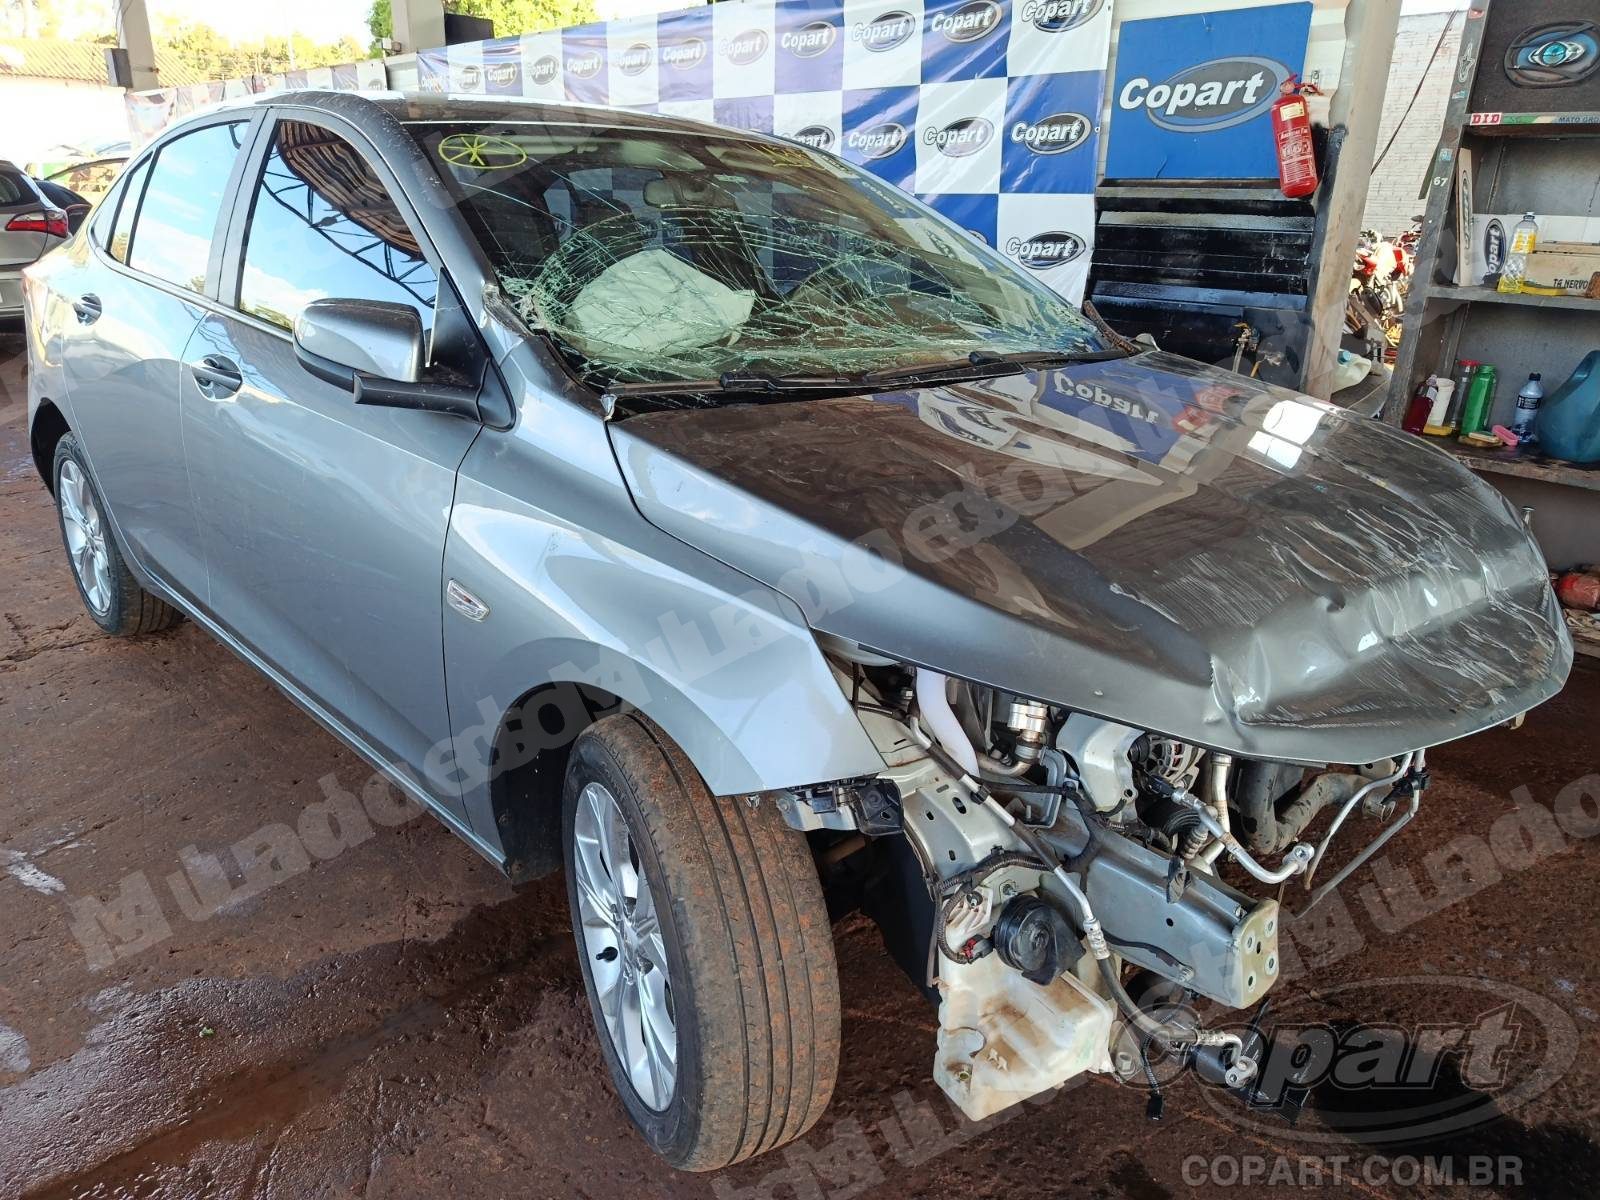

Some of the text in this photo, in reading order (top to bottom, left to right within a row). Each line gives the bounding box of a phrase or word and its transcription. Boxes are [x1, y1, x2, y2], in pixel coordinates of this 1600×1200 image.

[931, 7, 994, 33] Copart
[1021, 0, 1093, 25] Copart
[780, 28, 830, 50] Copart
[852, 19, 907, 43] Copart
[566, 56, 598, 76] Copart
[662, 43, 702, 66] Copart
[1118, 70, 1265, 116] Copart
[1471, 113, 1500, 124] DID
[1558, 115, 1580, 123] MATO
[849, 129, 904, 150] Copart
[923, 124, 984, 148] Copart
[1011, 119, 1083, 144] Copart
[1433, 177, 1448, 187] 67
[1005, 235, 1076, 259] Copart
